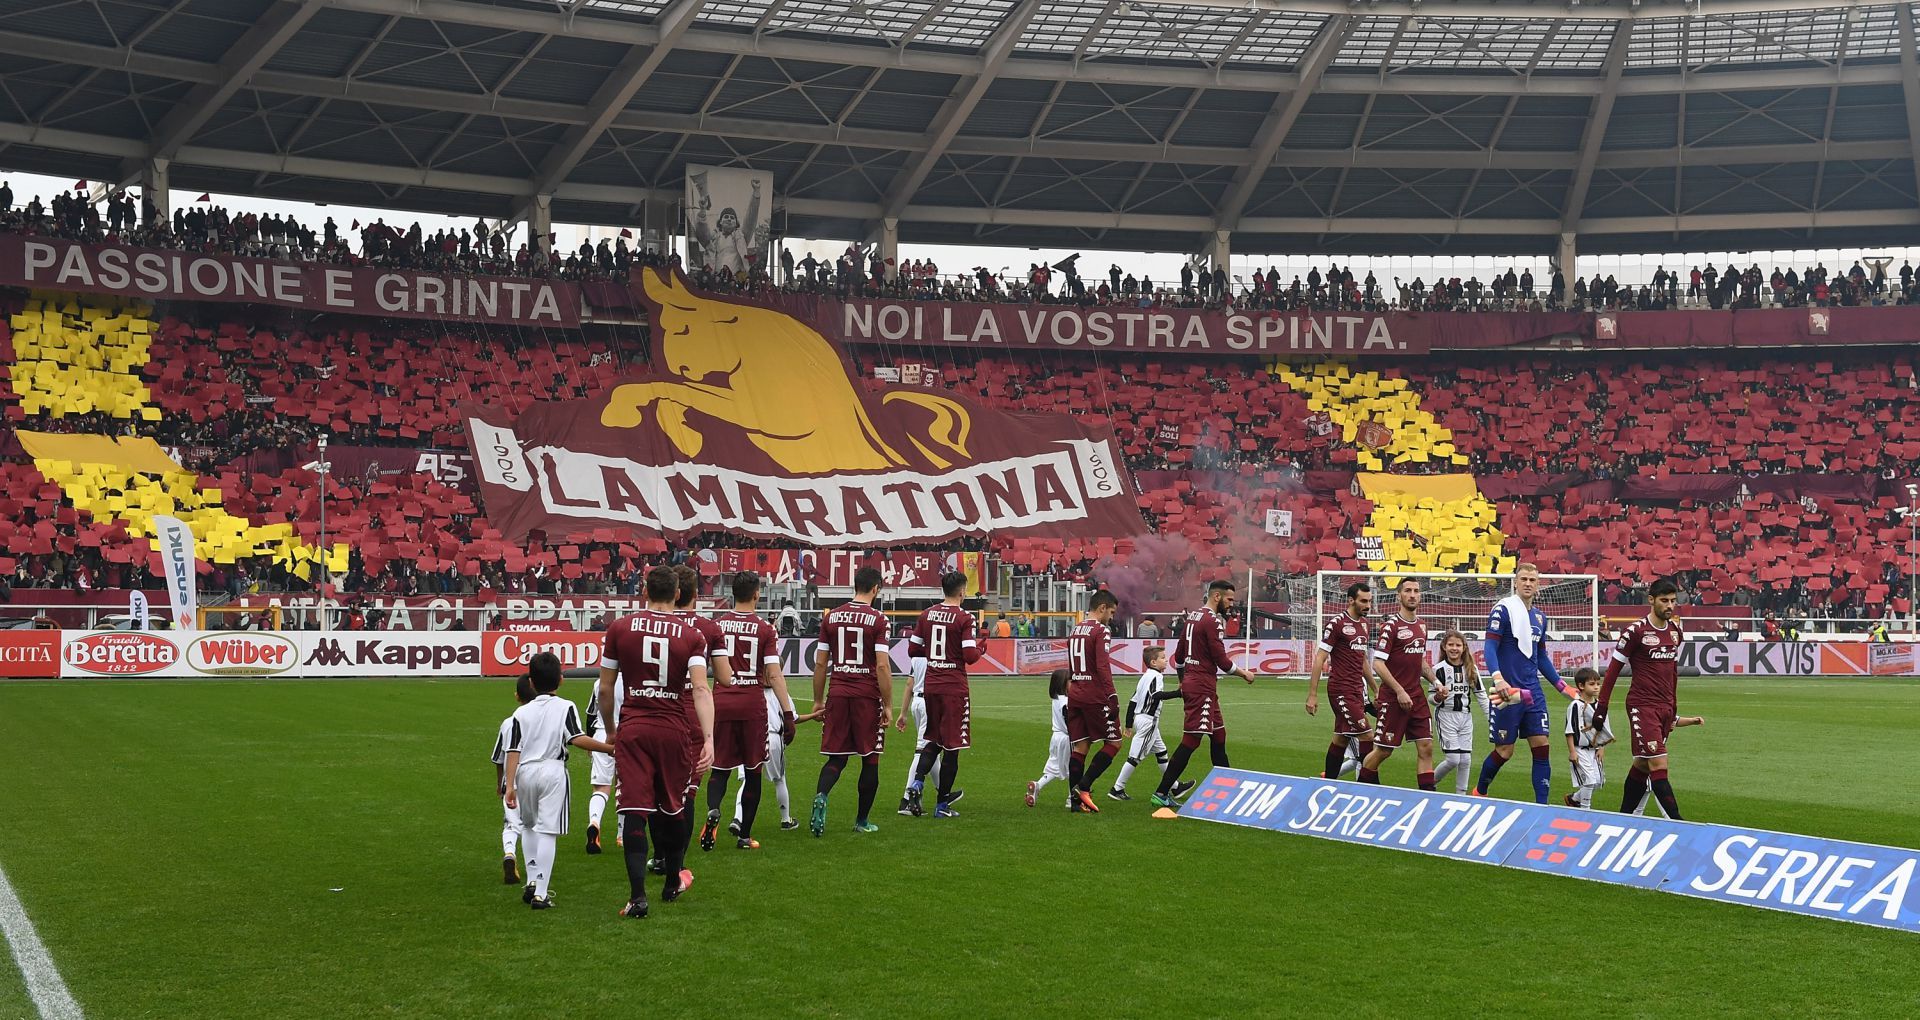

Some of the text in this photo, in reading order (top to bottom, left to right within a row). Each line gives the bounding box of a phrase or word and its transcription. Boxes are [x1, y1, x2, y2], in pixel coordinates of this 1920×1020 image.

[24, 241, 562, 322] PASSIONE E GRINTA
[844, 303, 1407, 350] NOI LA VOSTRA SPINTA.
[494, 432, 518, 484] 1906
[540, 452, 1079, 537] LA MARATONA
[167, 526, 188, 606] SUZUKI
[915, 556, 929, 570] 69
[1356, 548, 1385, 560] GOBBI
[630, 617, 683, 639] BELOTTI
[829, 611, 877, 627] ROSSETTINI
[927, 610, 957, 624] BASELLI
[68, 641, 175, 665] Beretta
[99, 636, 142, 645] Fratelli
[200, 639, 288, 665] Wüber
[356, 640, 480, 669] Kappa
[838, 626, 864, 665] 13
[930, 624, 947, 660] 8
[1070, 638, 1087, 672] 14
[1186, 623, 1194, 656] 4
[106, 664, 137, 672] 1812
[642, 635, 669, 687] 9
[1448, 684, 1469, 693] Jeep
[1224, 780, 1523, 857] TIM SERIE A TIM
[1578, 825, 1918, 921] TIM SERIE A
